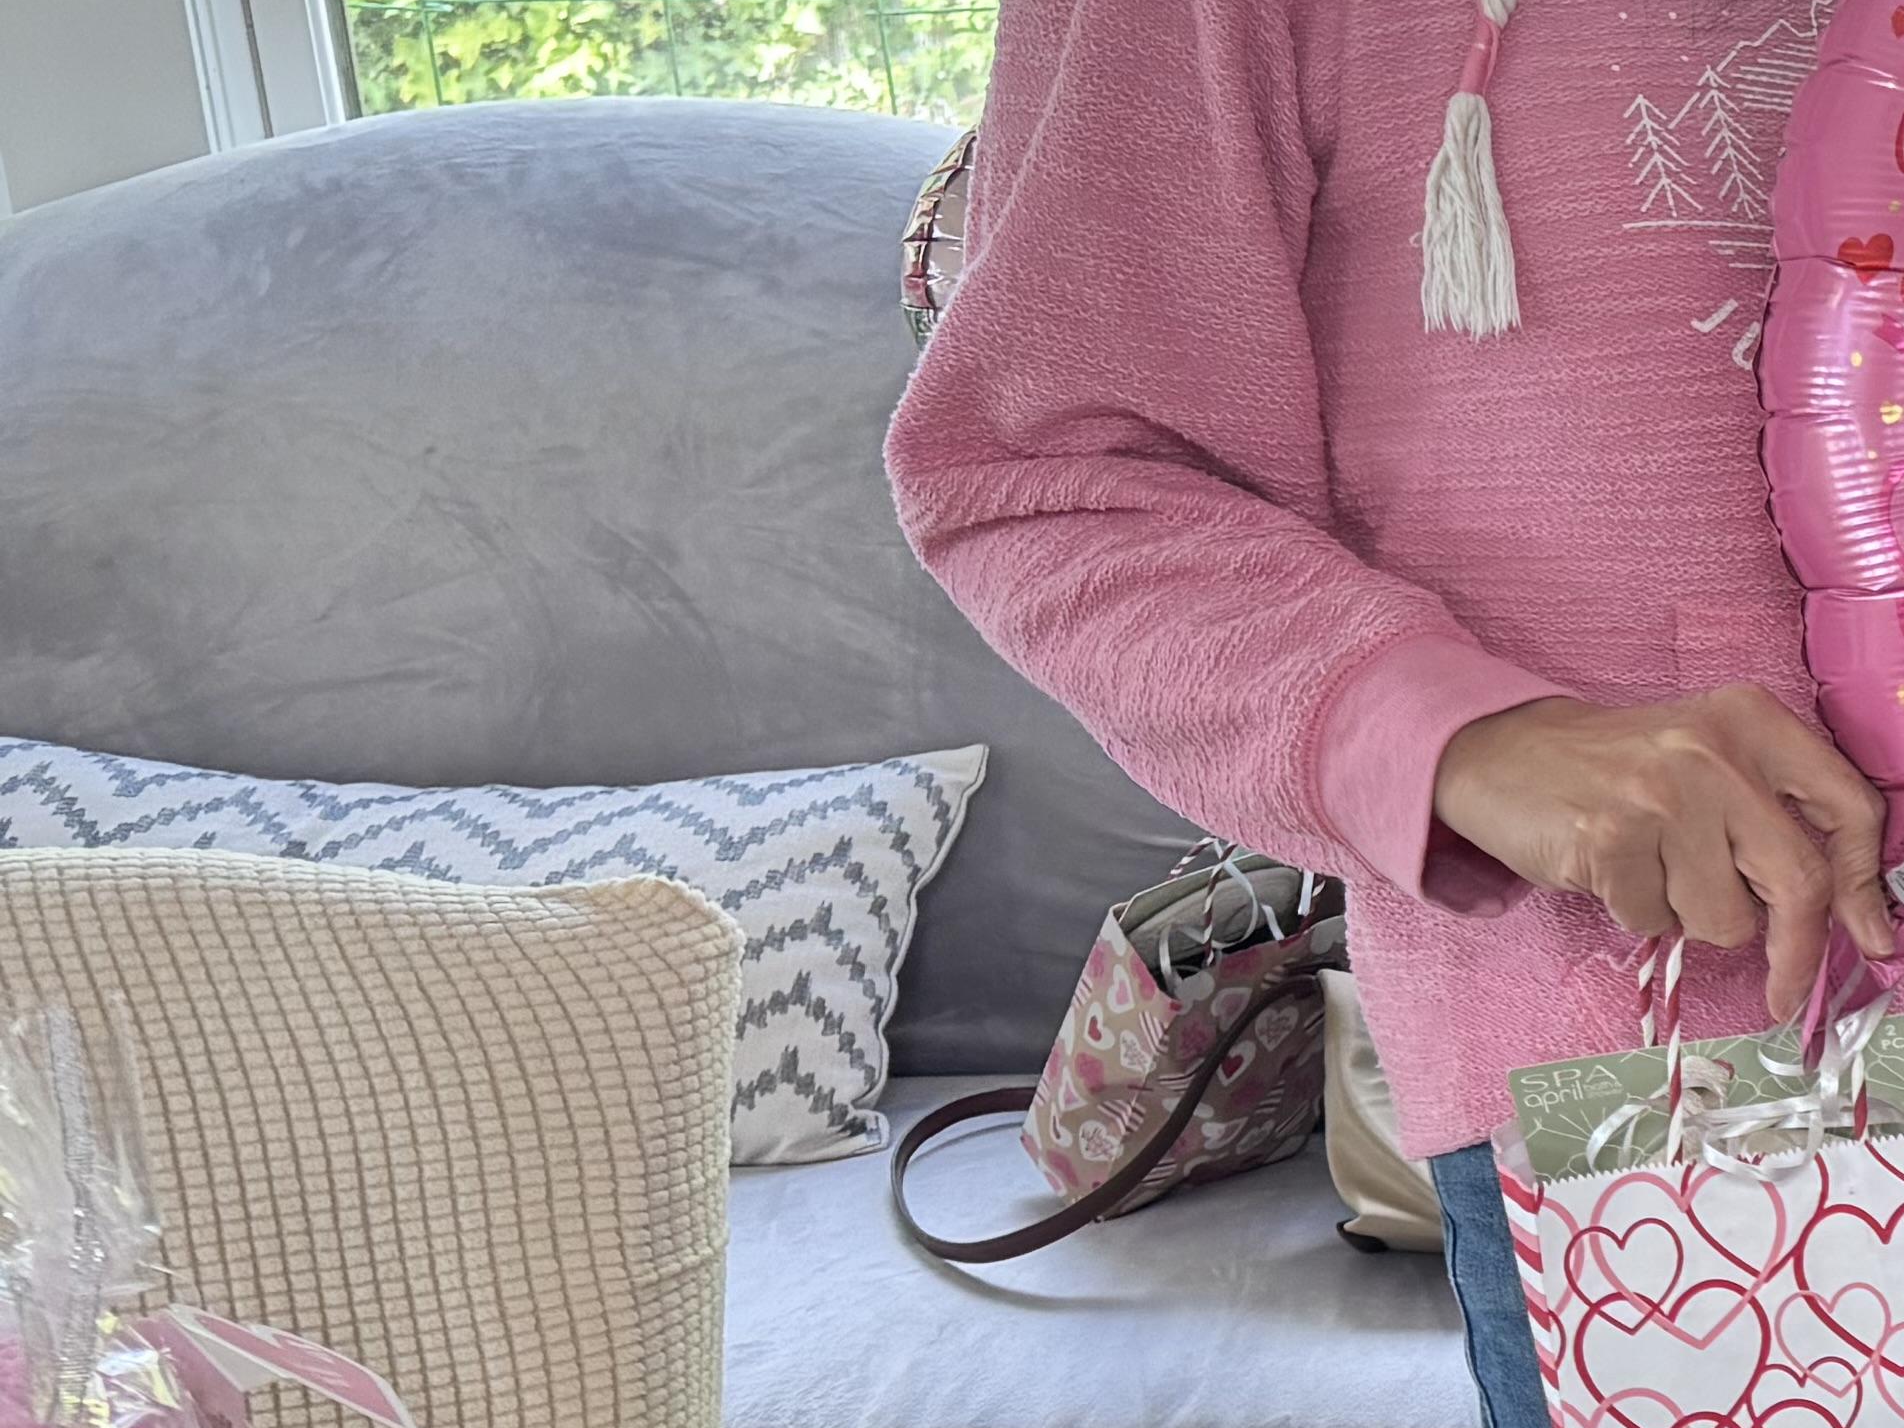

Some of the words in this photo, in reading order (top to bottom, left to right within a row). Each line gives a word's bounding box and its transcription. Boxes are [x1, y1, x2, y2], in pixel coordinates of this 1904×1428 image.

[1884, 1024, 1896, 1036] 2
[1520, 1065, 1622, 1092] SPA
[1523, 1080, 1584, 1114] april
